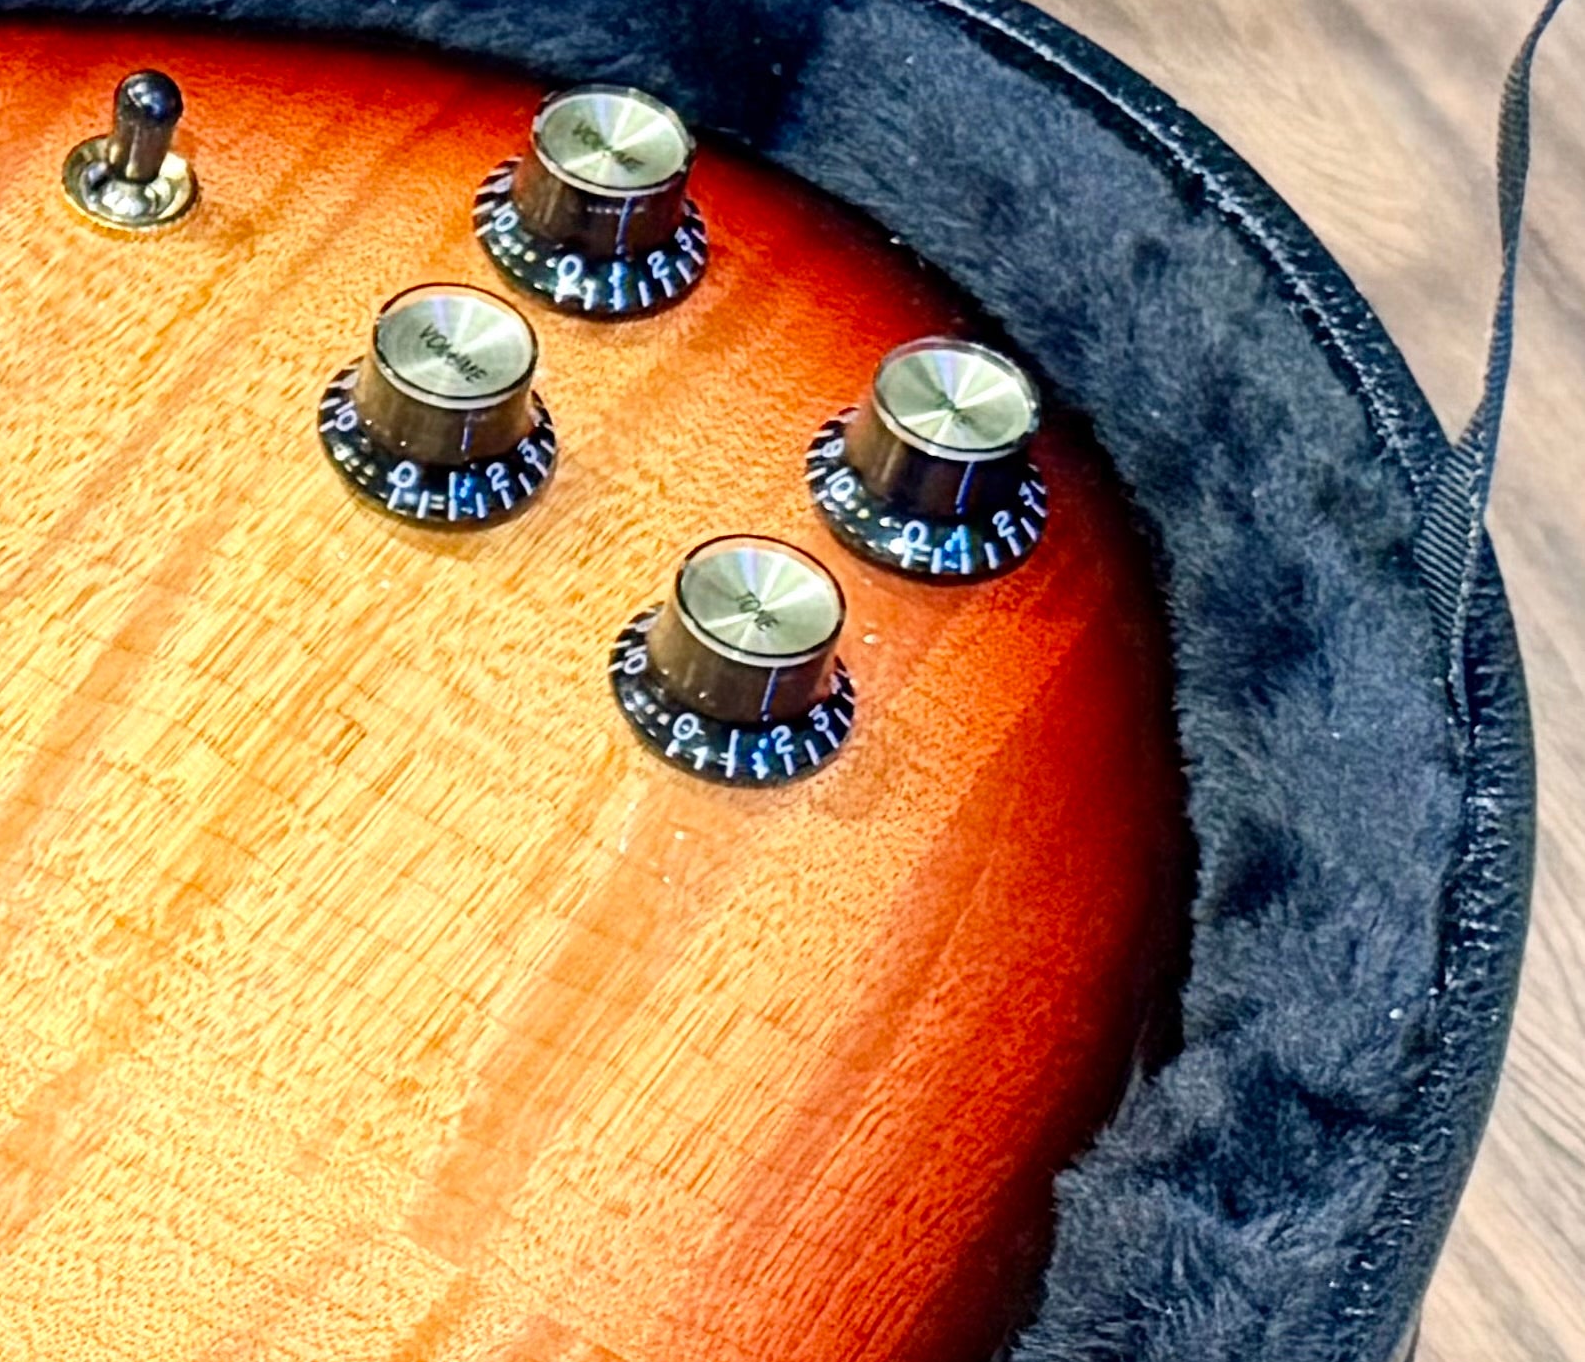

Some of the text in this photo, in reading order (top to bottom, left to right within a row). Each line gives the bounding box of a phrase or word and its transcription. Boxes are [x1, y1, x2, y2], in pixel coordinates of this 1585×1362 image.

[486, 462, 509, 491] 2
[992, 510, 1016, 537] 2
[672, 712, 699, 740] 0
[771, 725, 794, 754] 2
